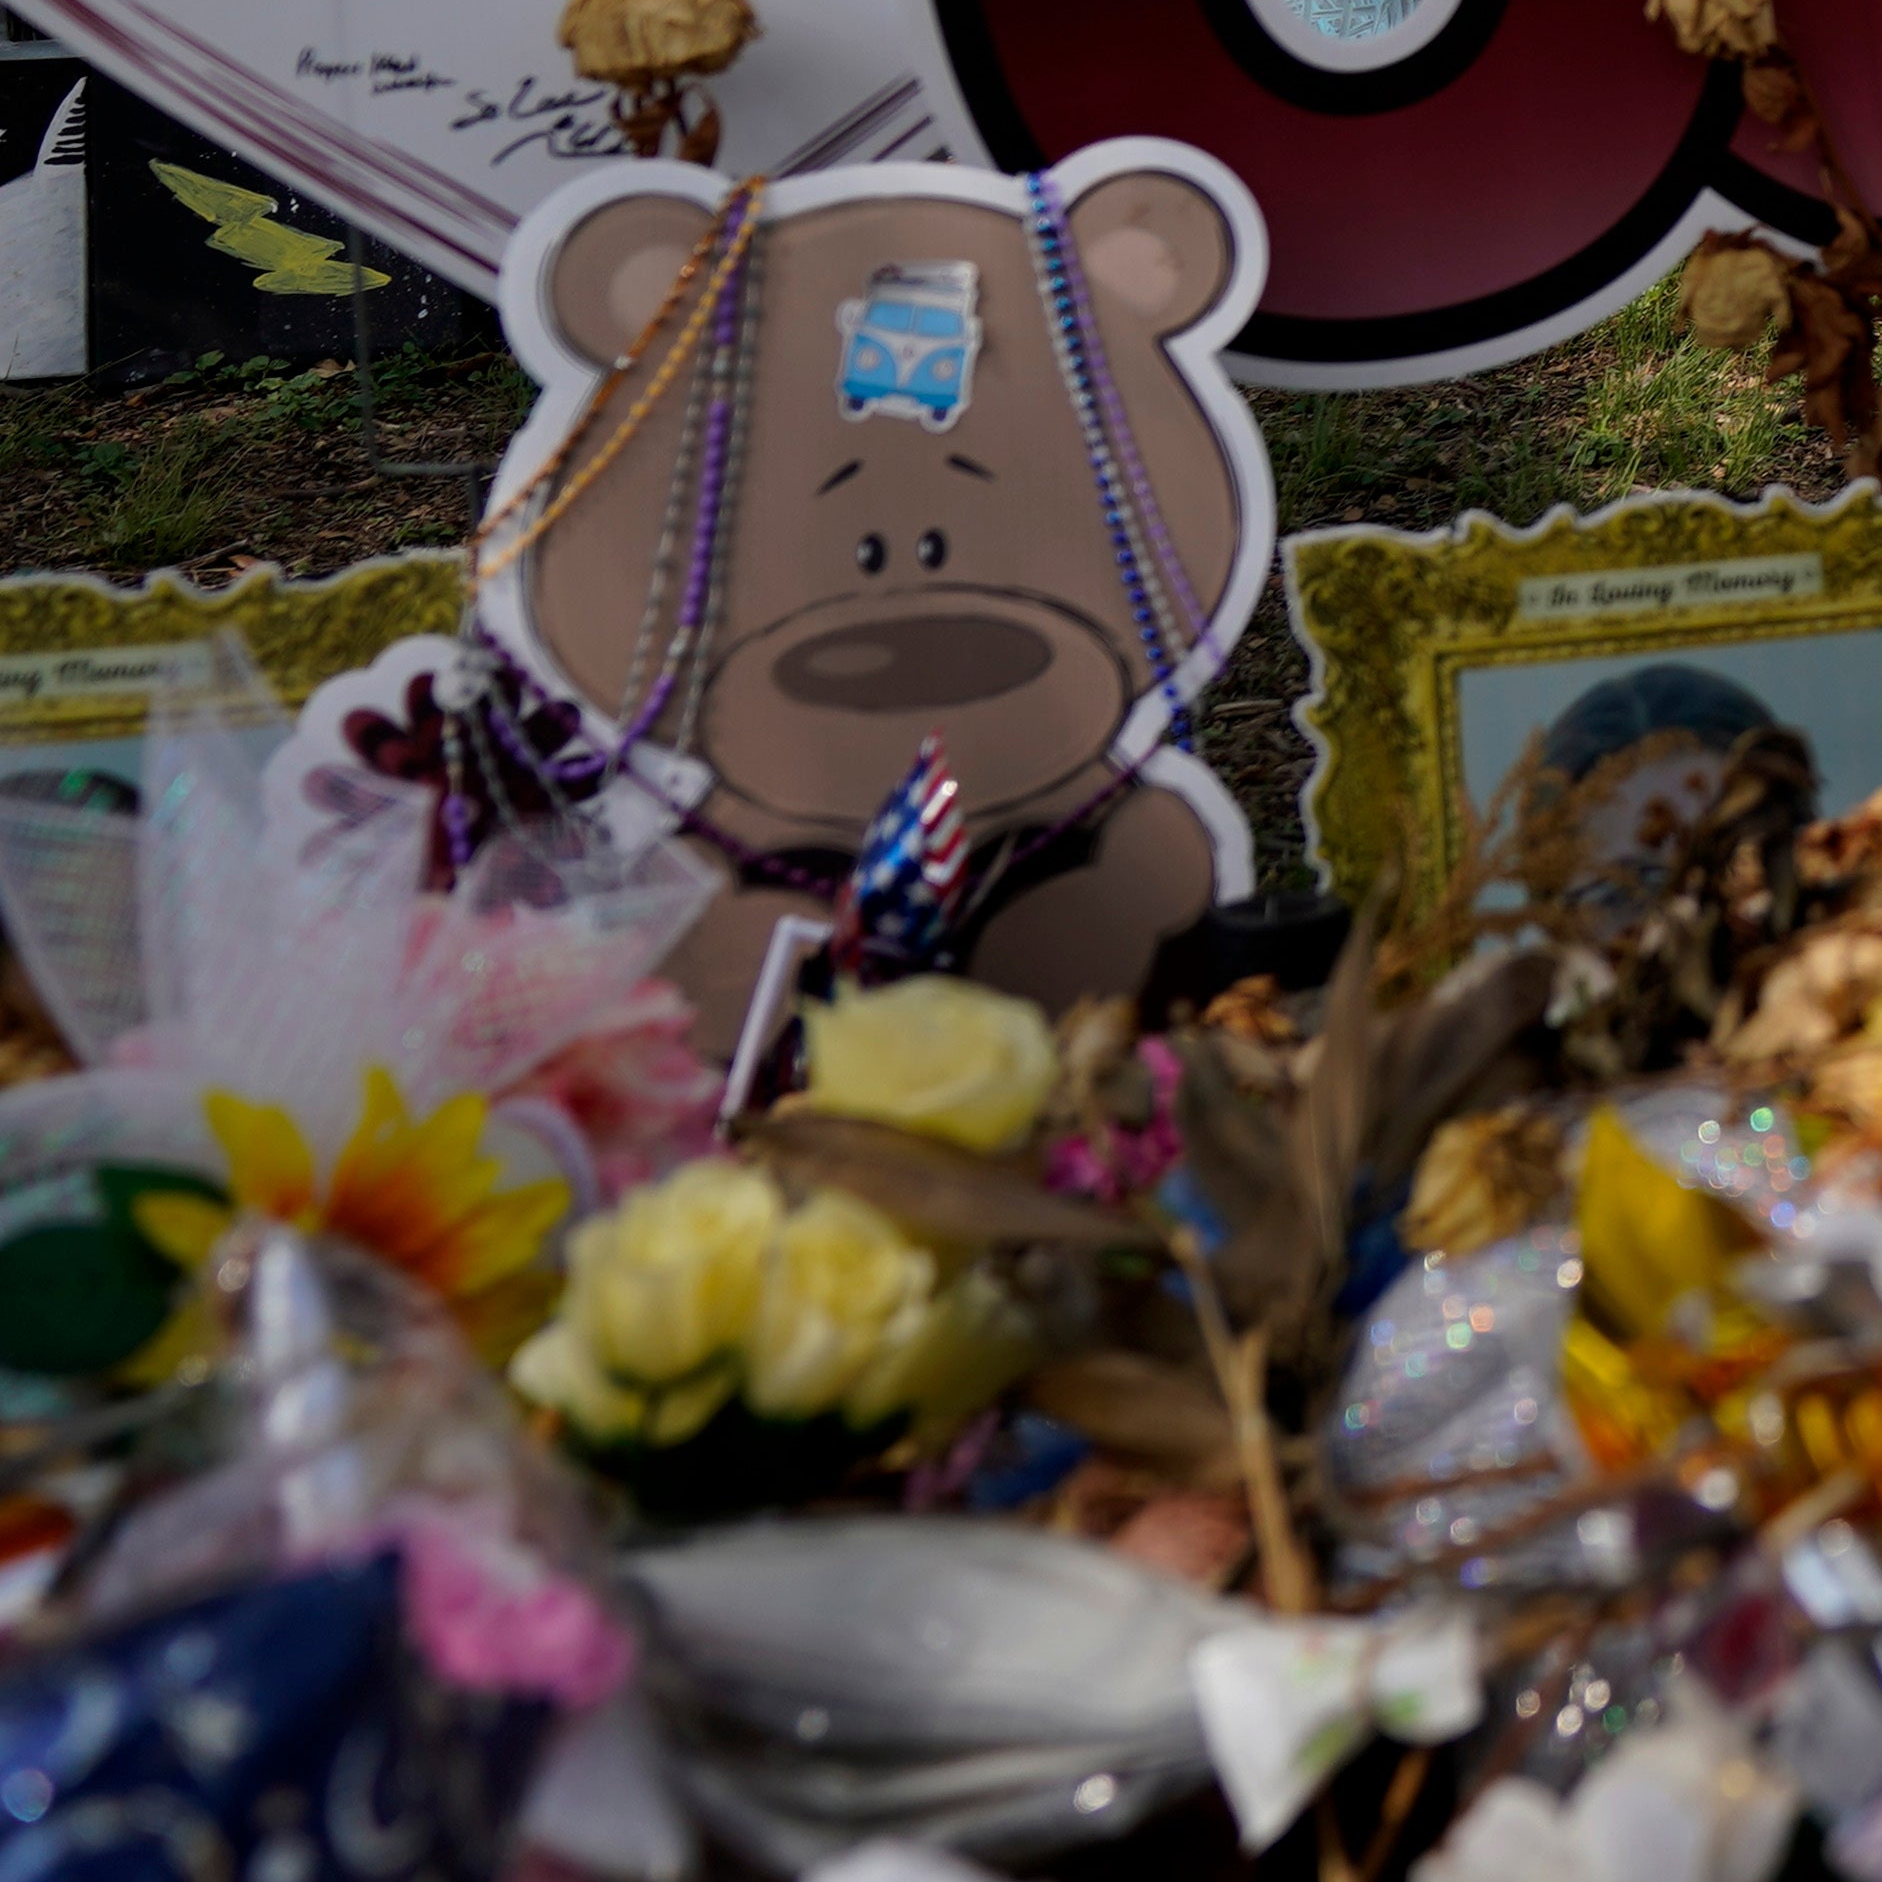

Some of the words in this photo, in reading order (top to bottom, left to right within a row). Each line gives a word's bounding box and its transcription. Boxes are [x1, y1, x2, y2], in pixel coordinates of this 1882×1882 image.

[1550, 581, 1578, 607] In
[1588, 577, 1674, 609] Loving
[1685, 568, 1797, 596] Memory
